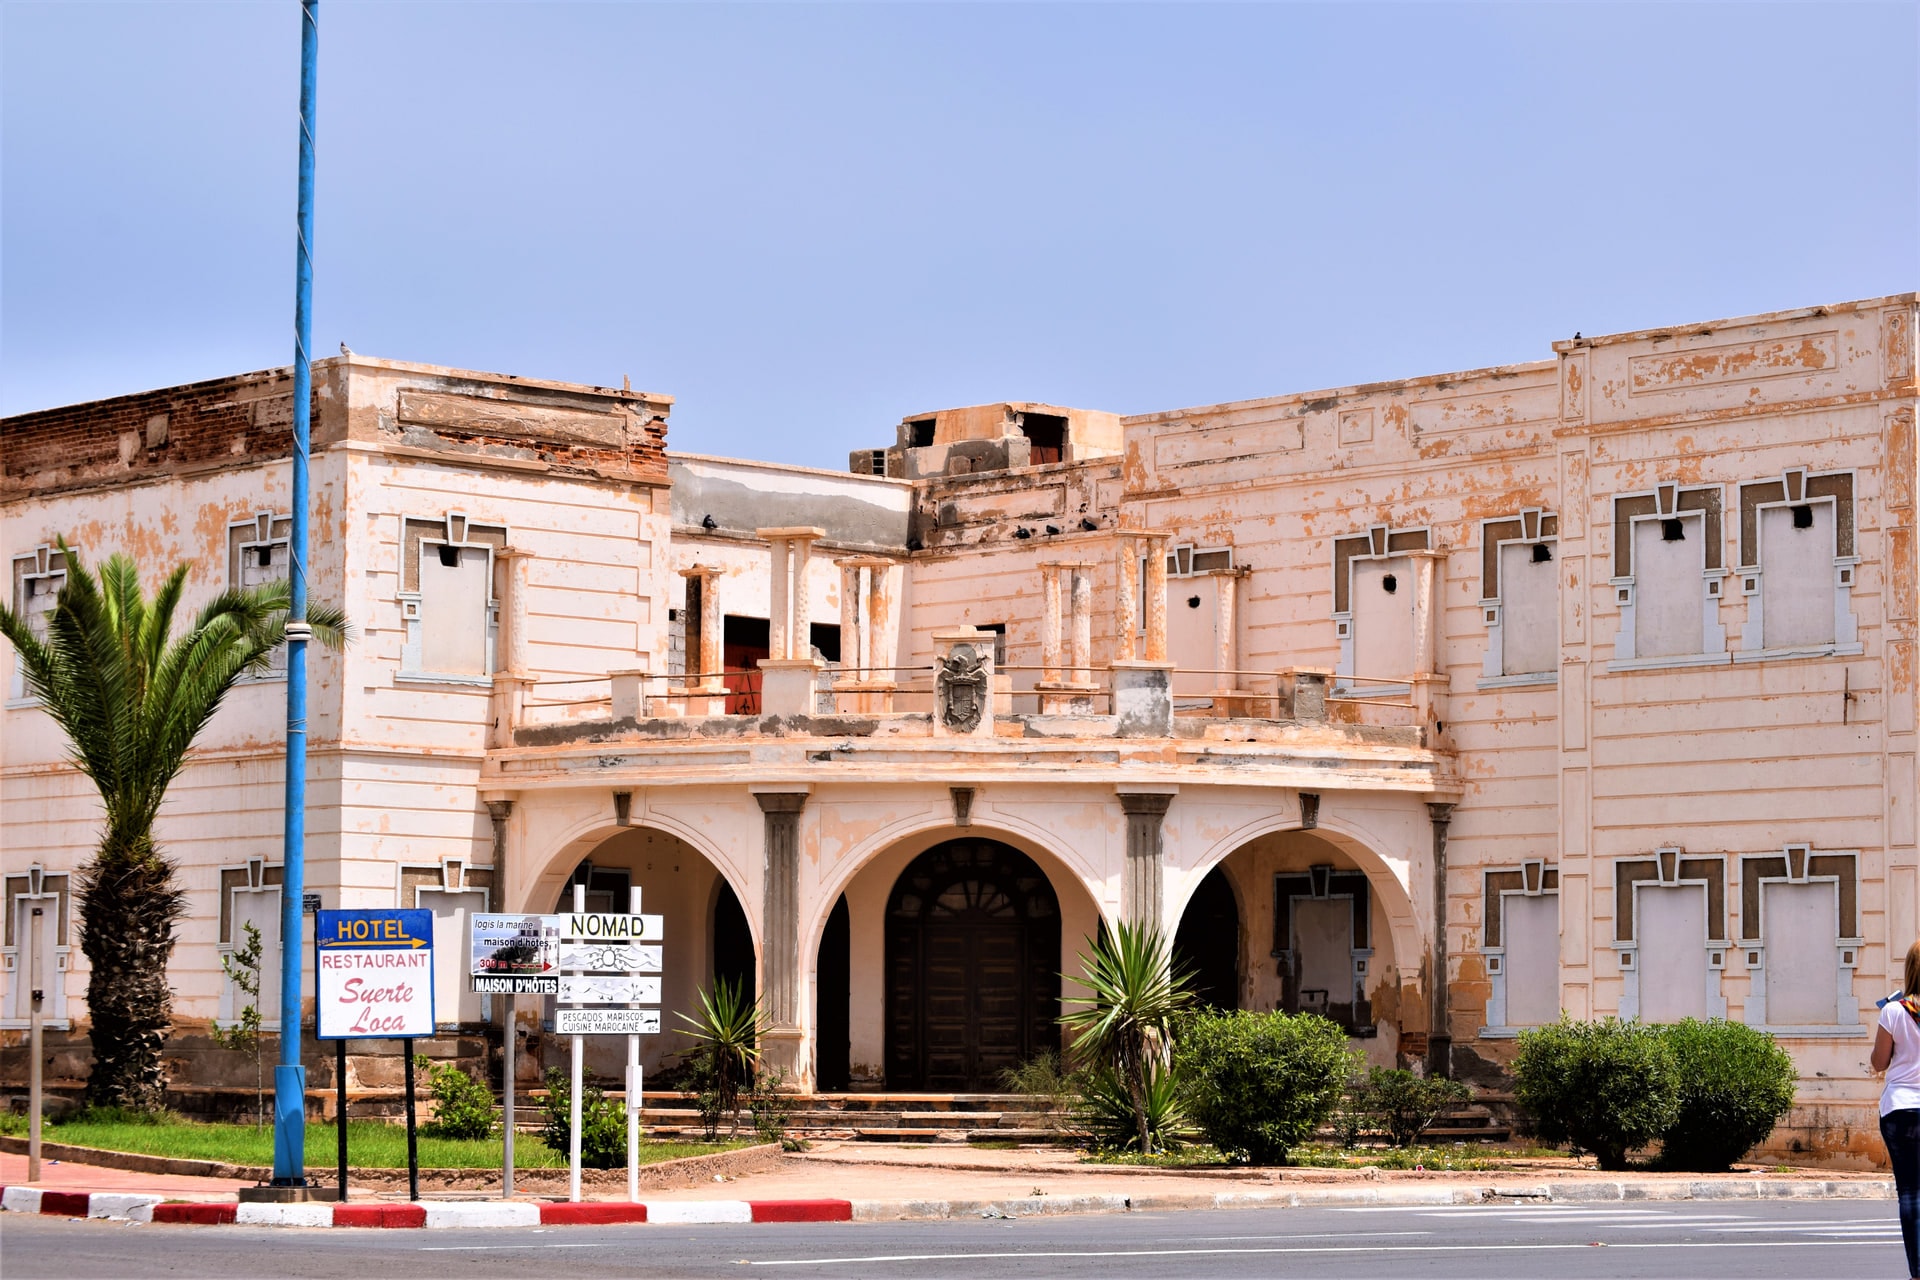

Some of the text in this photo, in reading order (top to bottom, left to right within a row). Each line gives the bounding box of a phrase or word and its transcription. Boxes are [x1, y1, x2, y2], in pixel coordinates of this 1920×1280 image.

[338, 920, 410, 939] HOTEL
[475, 919, 534, 930] logis la marine
[571, 915, 644, 937] NOMAD
[484, 938, 515, 947] maison
[322, 954, 428, 968] RESTAURANT
[480, 959, 497, 968] 300
[339, 977, 413, 1003] Suerte
[475, 976, 557, 993] MAISON D'HÔTES
[349, 1006, 406, 1033] Loca
[563, 1012, 644, 1022] PESCADOS MARISCOS
[562, 1021, 640, 1032] CUISINE MAROCAINE
